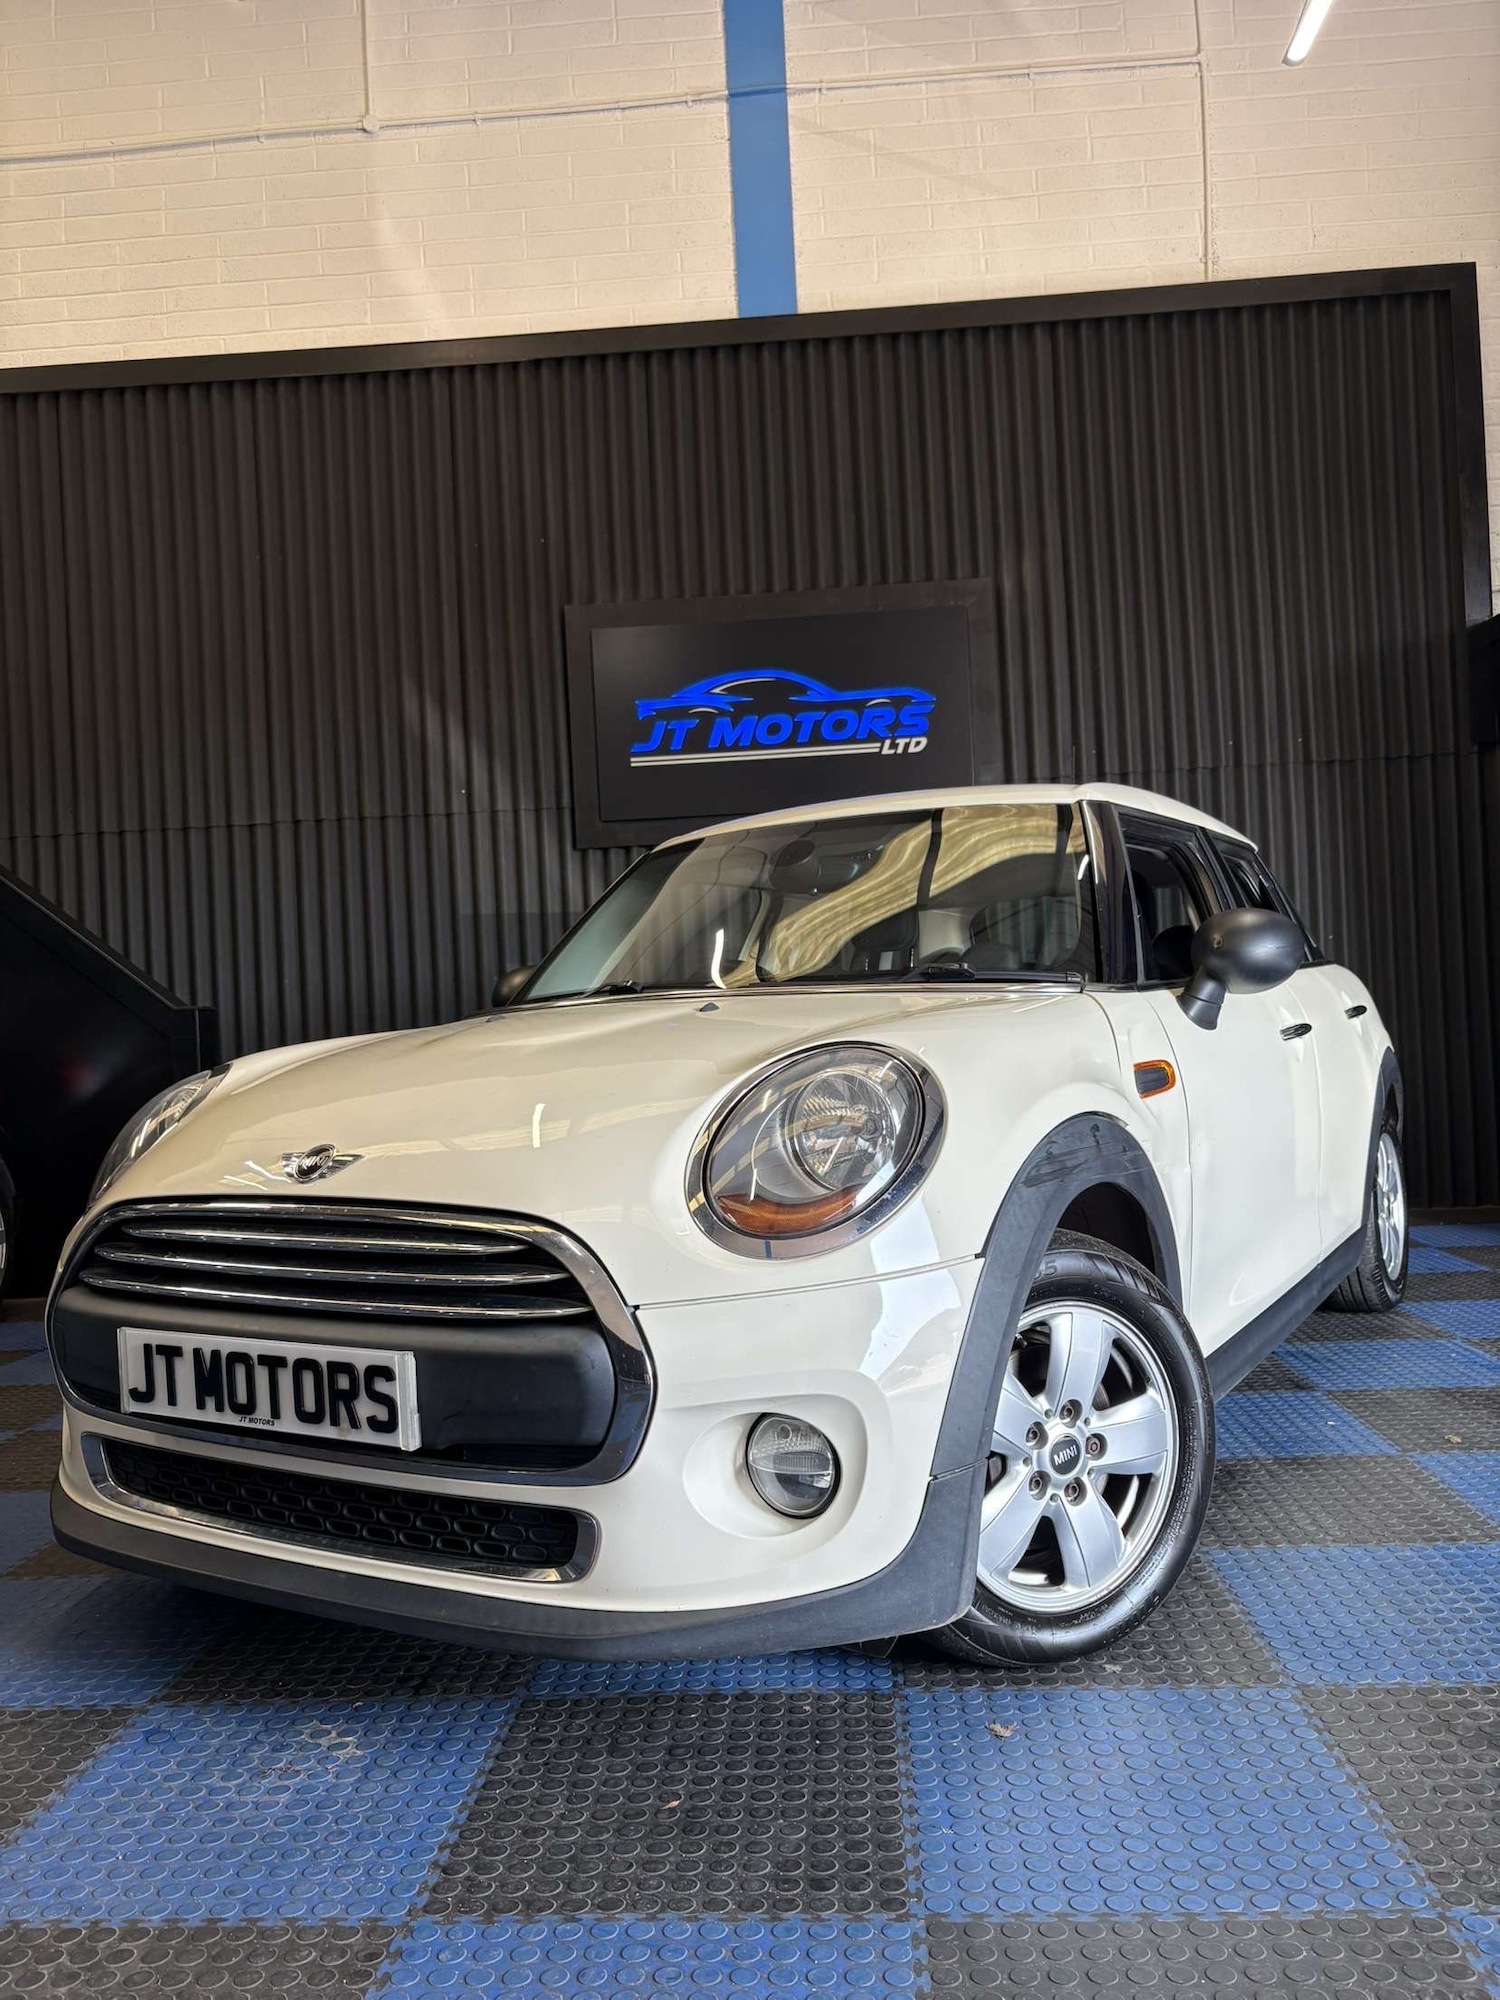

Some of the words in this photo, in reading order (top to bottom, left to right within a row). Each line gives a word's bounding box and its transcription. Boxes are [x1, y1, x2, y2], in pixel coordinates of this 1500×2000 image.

[630, 720, 700, 753] JT
[707, 704, 936, 748] MOTORS
[880, 736, 929, 755] LTD
[128, 1343, 184, 1407] JT
[192, 1347, 399, 1433] MOTORS
[249, 1416, 275, 1426] MOTORS
[1053, 1444, 1078, 1466] MINI
